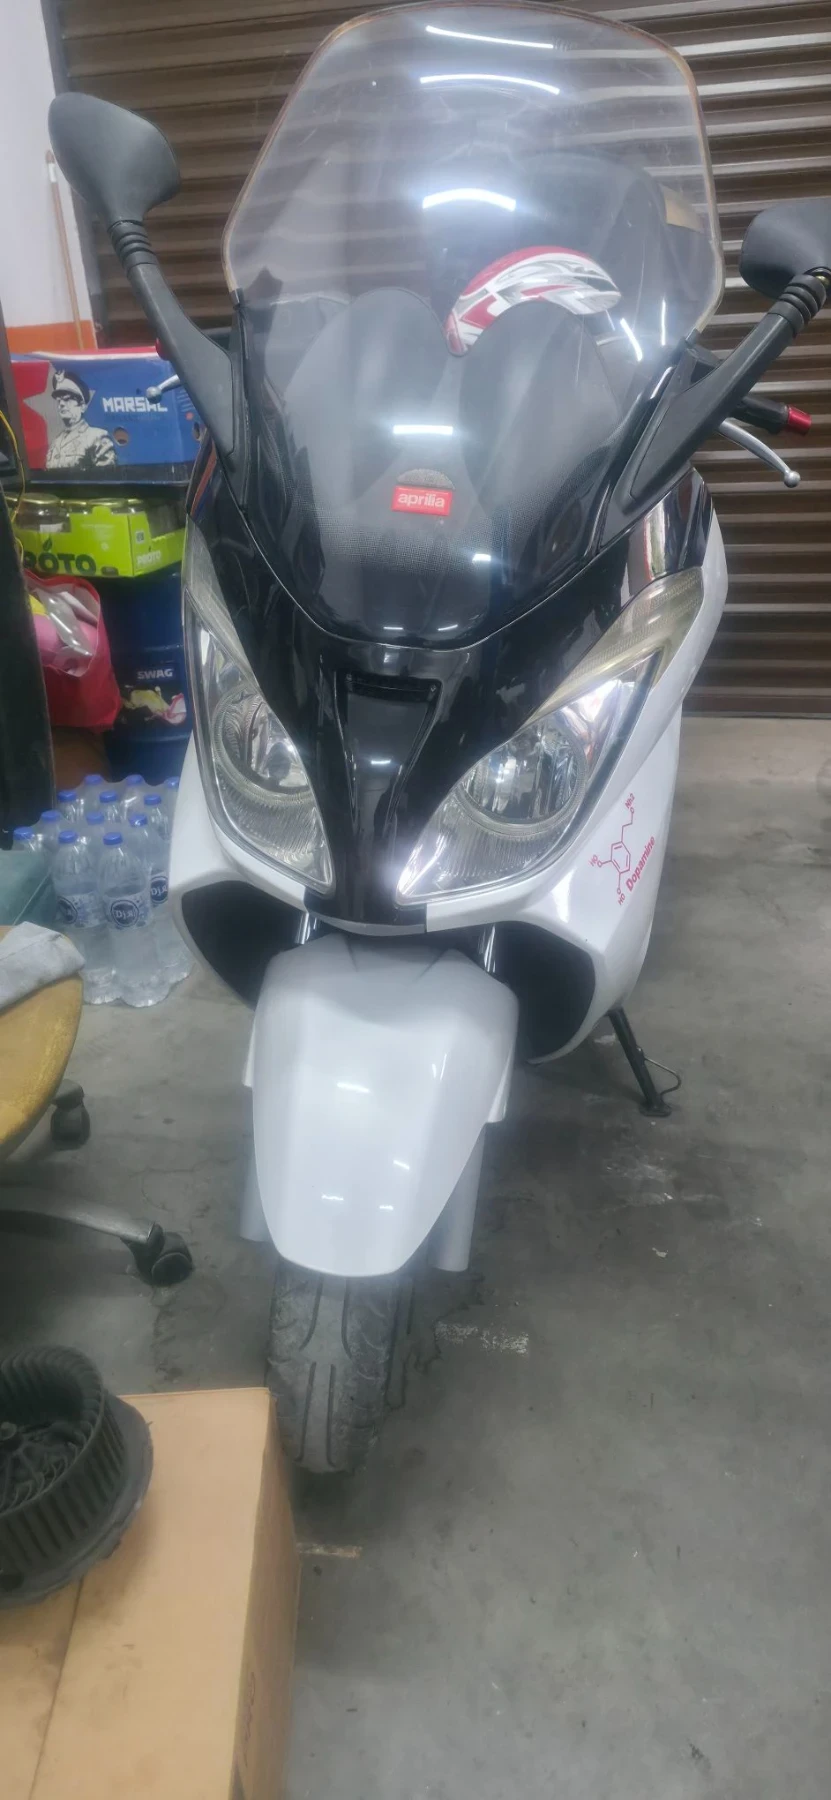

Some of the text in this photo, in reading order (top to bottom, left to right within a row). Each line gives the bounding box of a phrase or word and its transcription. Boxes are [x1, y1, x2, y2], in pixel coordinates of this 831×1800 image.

[397, 493, 446, 508] aprilia
[23, 552, 97, 576] ROTO
[137, 668, 174, 679] SWAG
[625, 836, 656, 892] Dopamine
